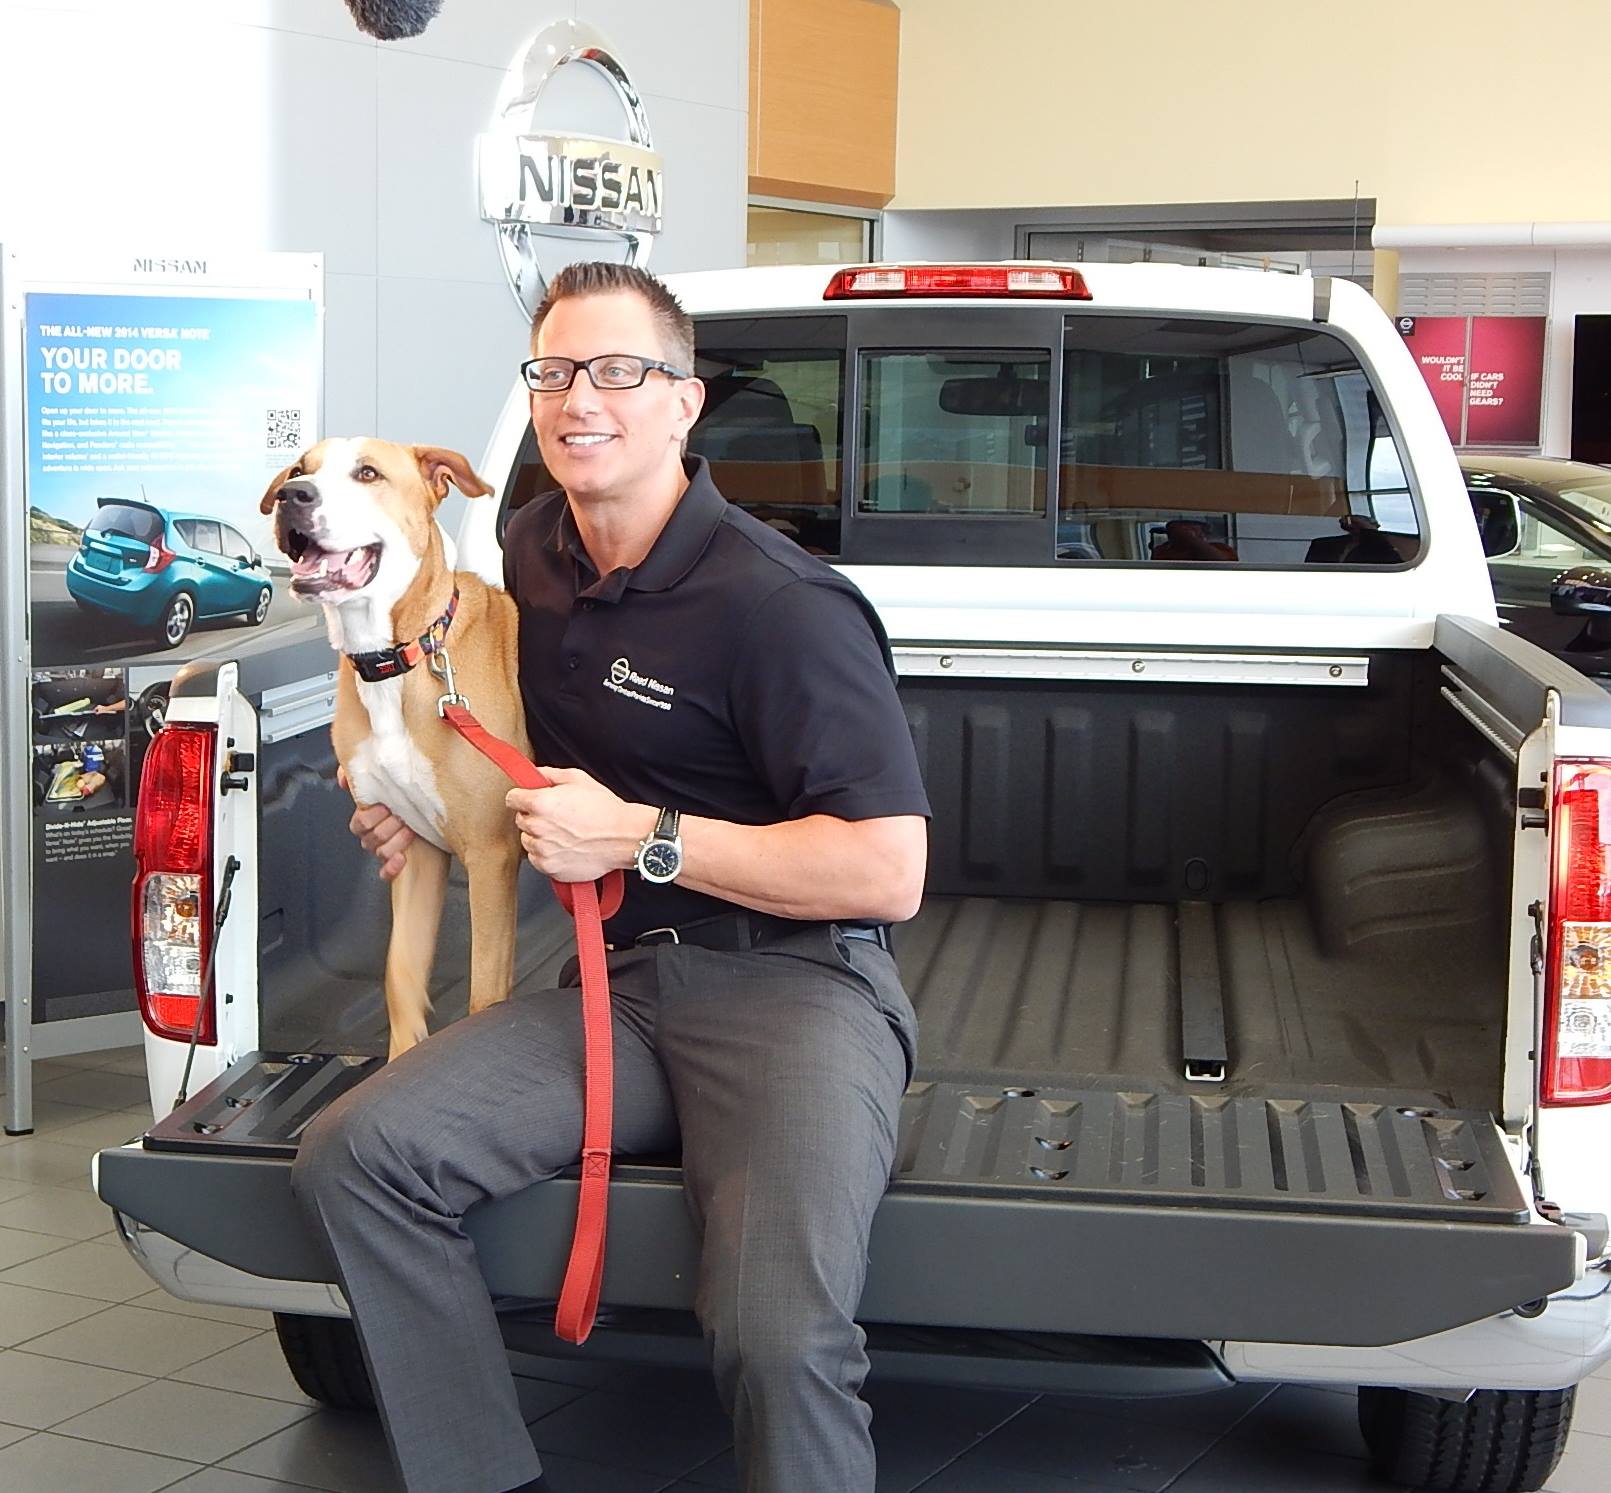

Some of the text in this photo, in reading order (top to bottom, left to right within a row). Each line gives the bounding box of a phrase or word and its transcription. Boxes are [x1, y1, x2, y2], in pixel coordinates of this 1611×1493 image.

[518, 154, 662, 216] NISSAN
[134, 259, 206, 274] NISSAN
[39, 324, 63, 337] THE
[64, 325, 112, 338] ALL-NEW
[115, 327, 139, 339] 2014
[40, 346, 182, 371] YOUR DOOR
[1421, 356, 1465, 364] WOULDN'T
[40, 371, 154, 394] TO MORE.
[1440, 373, 1463, 381] COOL
[1480, 373, 1504, 381] CARS
[1470, 381, 1498, 389] DIDN'T
[1469, 398, 1504, 406] GEARS?
[629, 672, 649, 686] Reed
[648, 679, 675, 695] Nissan
